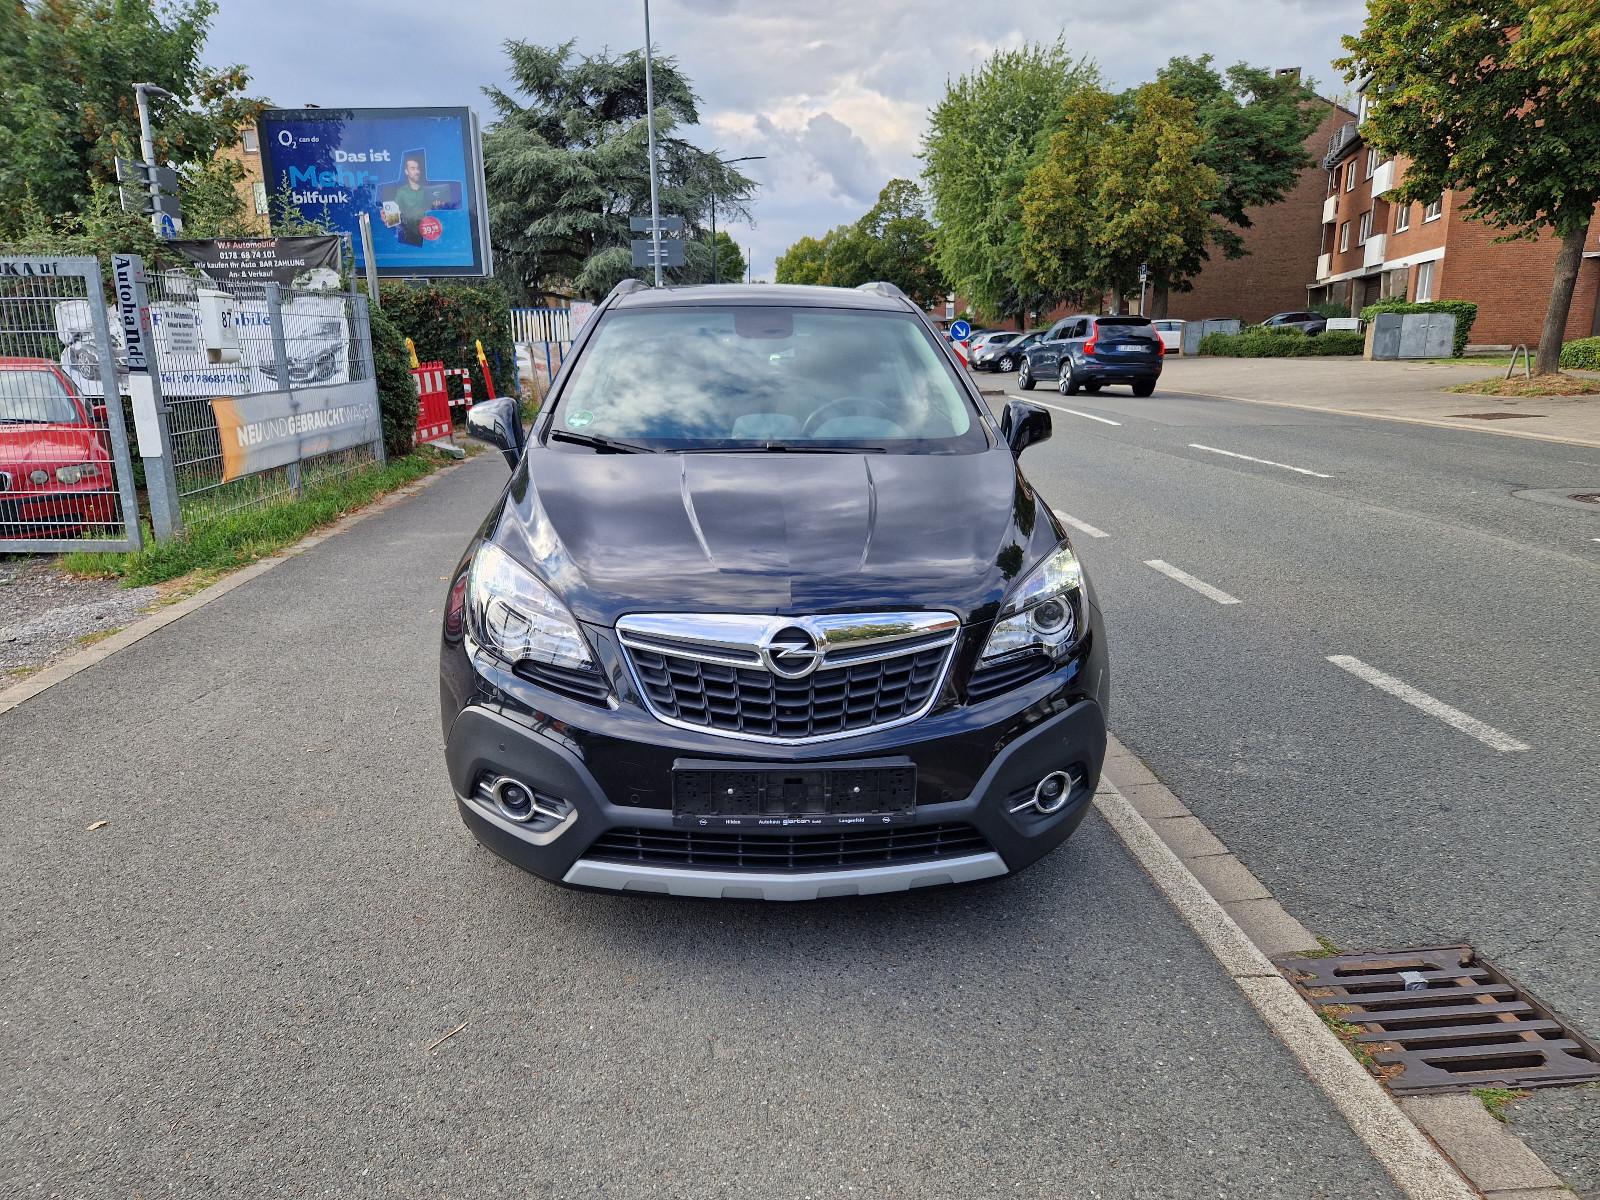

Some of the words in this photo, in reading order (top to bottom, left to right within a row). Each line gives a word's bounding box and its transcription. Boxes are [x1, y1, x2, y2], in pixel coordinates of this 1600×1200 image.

[335, 150, 367, 163] Das
[369, 149, 391, 162] ist
[289, 165, 379, 187] Mehr-
[292, 191, 349, 204] bilfunk
[220, 251, 237, 259] 0178
[241, 251, 250, 259] 68
[252, 250, 261, 259] 74
[262, 250, 276, 258] 101
[274, 259, 305, 267] ZAHLUNG
[221, 311, 232, 328] 87
[838, 817, 865, 825] Langenfeld
